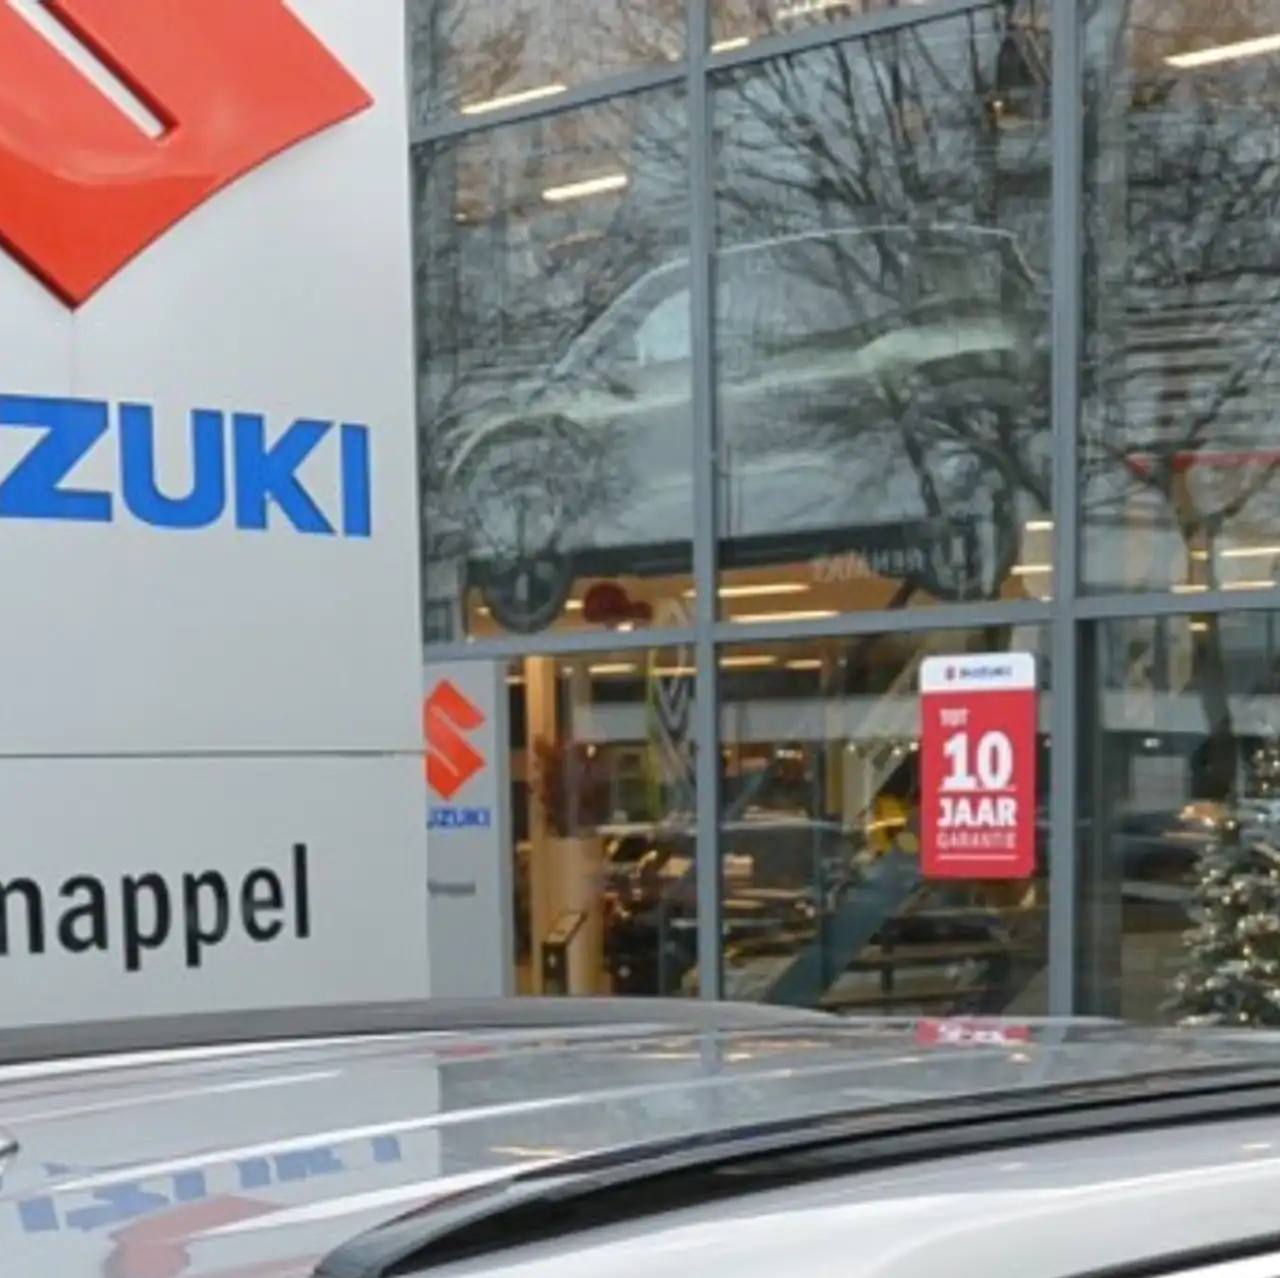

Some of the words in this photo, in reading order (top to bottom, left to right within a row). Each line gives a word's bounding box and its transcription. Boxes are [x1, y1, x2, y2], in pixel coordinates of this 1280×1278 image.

[940, 708, 969, 727] TOT
[941, 730, 1014, 790] 10
[936, 796, 1018, 827] JAAR
[936, 830, 1017, 850] GARANTIE
